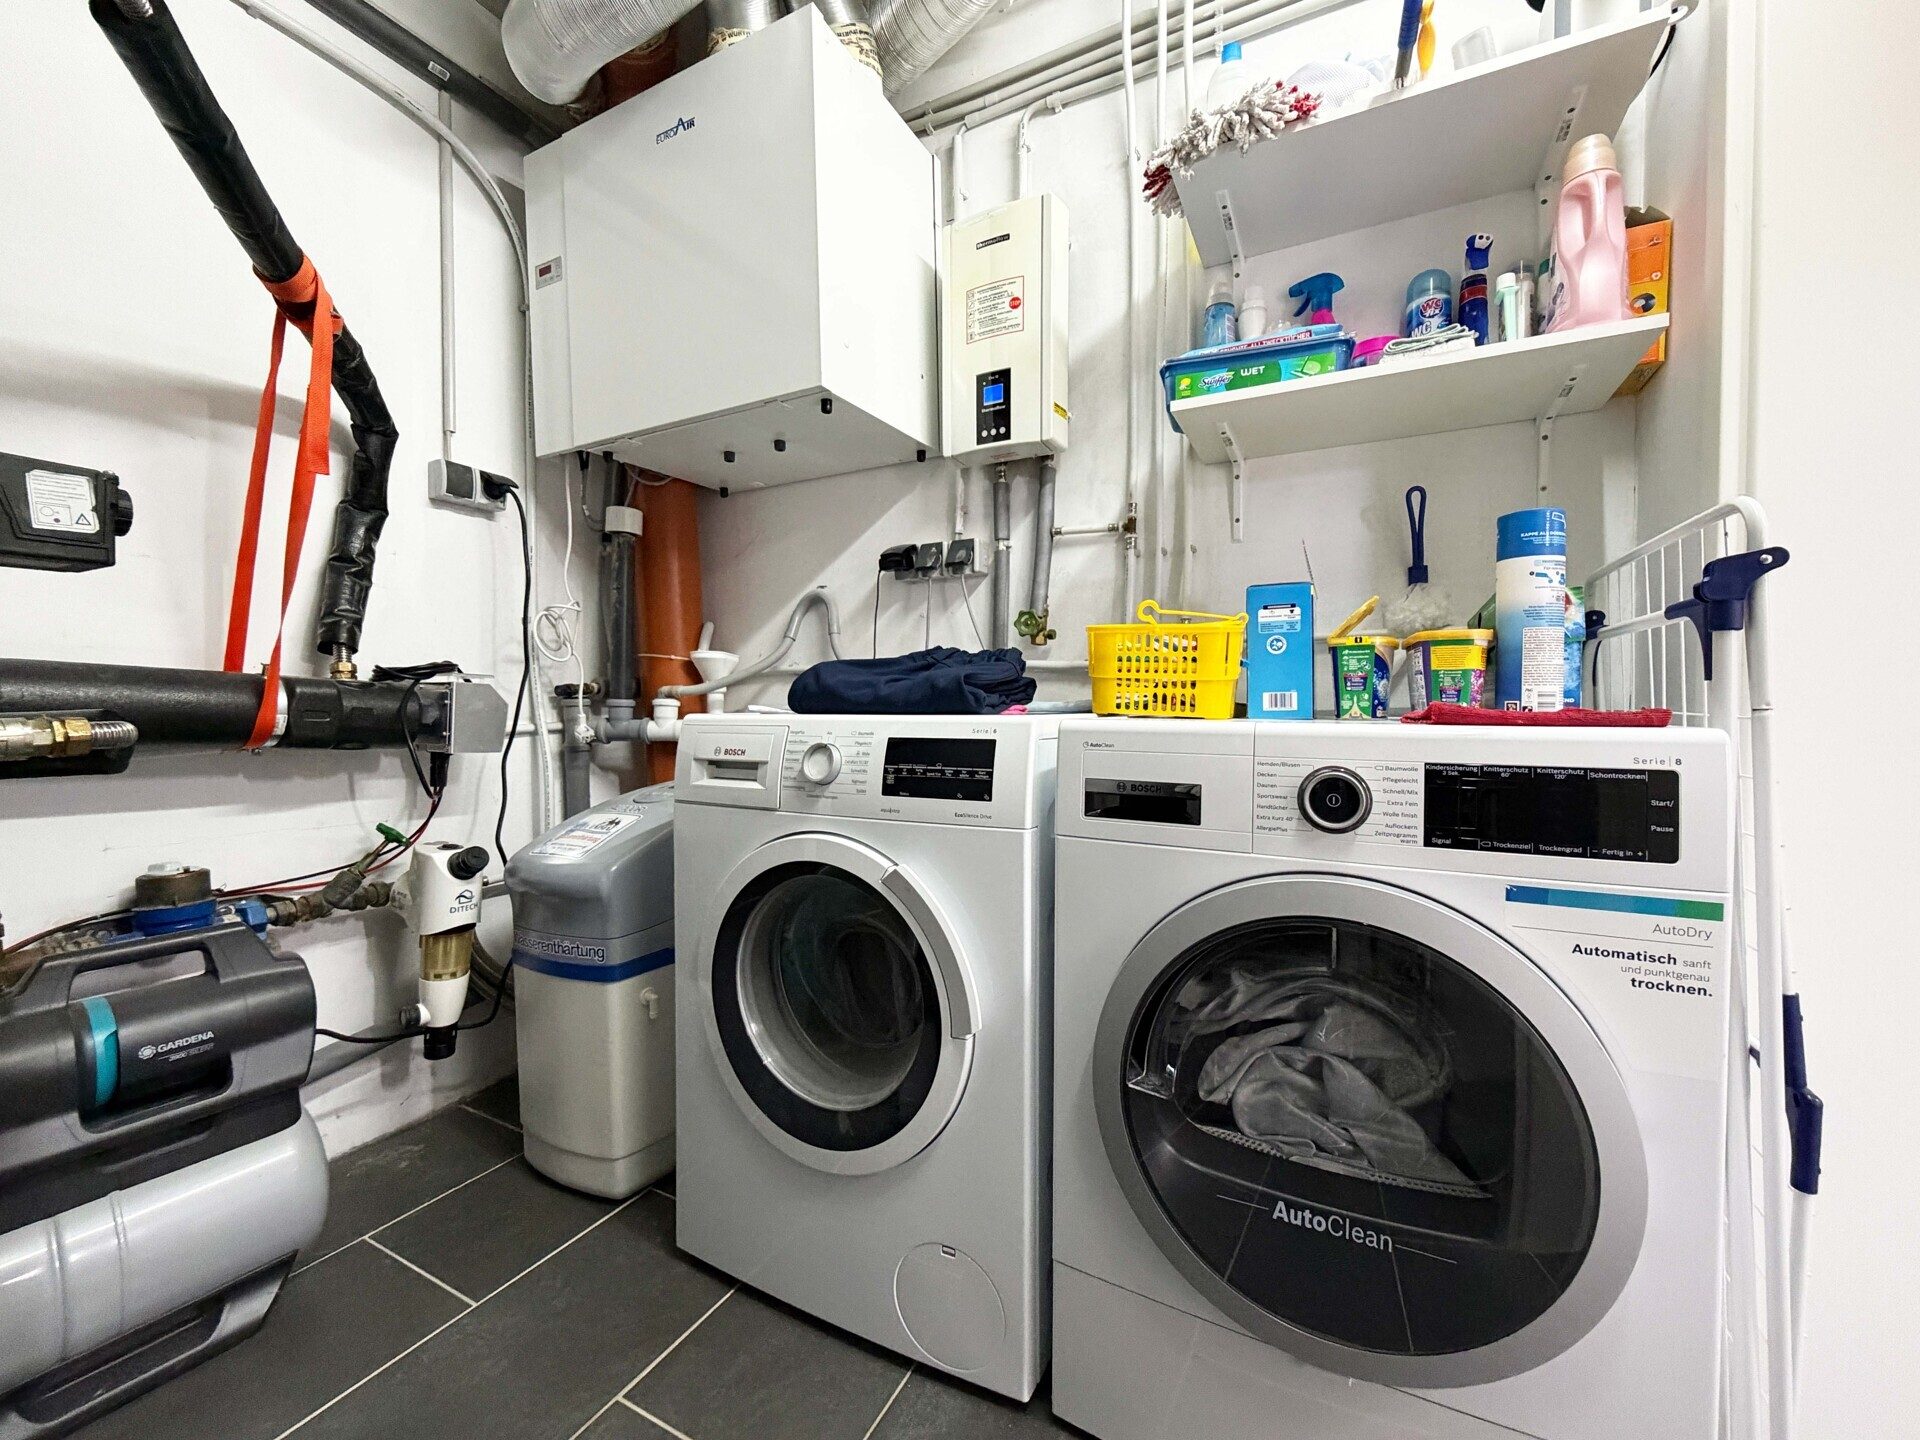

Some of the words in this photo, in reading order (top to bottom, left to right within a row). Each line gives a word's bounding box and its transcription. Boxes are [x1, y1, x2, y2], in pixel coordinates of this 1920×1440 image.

[1010, 299, 1021, 307] STOP
[1421, 298, 1441, 311] WC
[1411, 321, 1432, 338] WC
[1199, 374, 1234, 388] Swiffer
[1240, 366, 1266, 377] WET
[724, 748, 746, 756] BOSCH
[1634, 757, 1666, 765] Serie
[1675, 758, 1682, 766] 8
[1425, 764, 1478, 773] Kindersicherung
[1382, 776, 1418, 784] Pflegeleicht
[1590, 771, 1646, 780] Schontrocknen
[1130, 784, 1162, 793] BOSCH
[1384, 822, 1418, 830] Auflockern
[1650, 825, 1674, 833] Pause
[1374, 830, 1418, 839] Zeitprogramm
[1431, 837, 1452, 845] Signal
[1492, 841, 1531, 850] Trockenziel
[1539, 844, 1583, 854] Trockengrad
[1602, 848, 1624, 857] Fertig
[449, 901, 478, 914] DITECH
[1652, 923, 1713, 941] AutoDry
[1572, 943, 1677, 965] Automatisch
[1682, 959, 1712, 970] sanft
[1620, 965, 1642, 975] und
[1644, 968, 1710, 983] punktgenau
[1631, 977, 1713, 997] trocknen.
[157, 1030, 215, 1053] GARDENA
[1272, 1200, 1393, 1253] AutoClean
